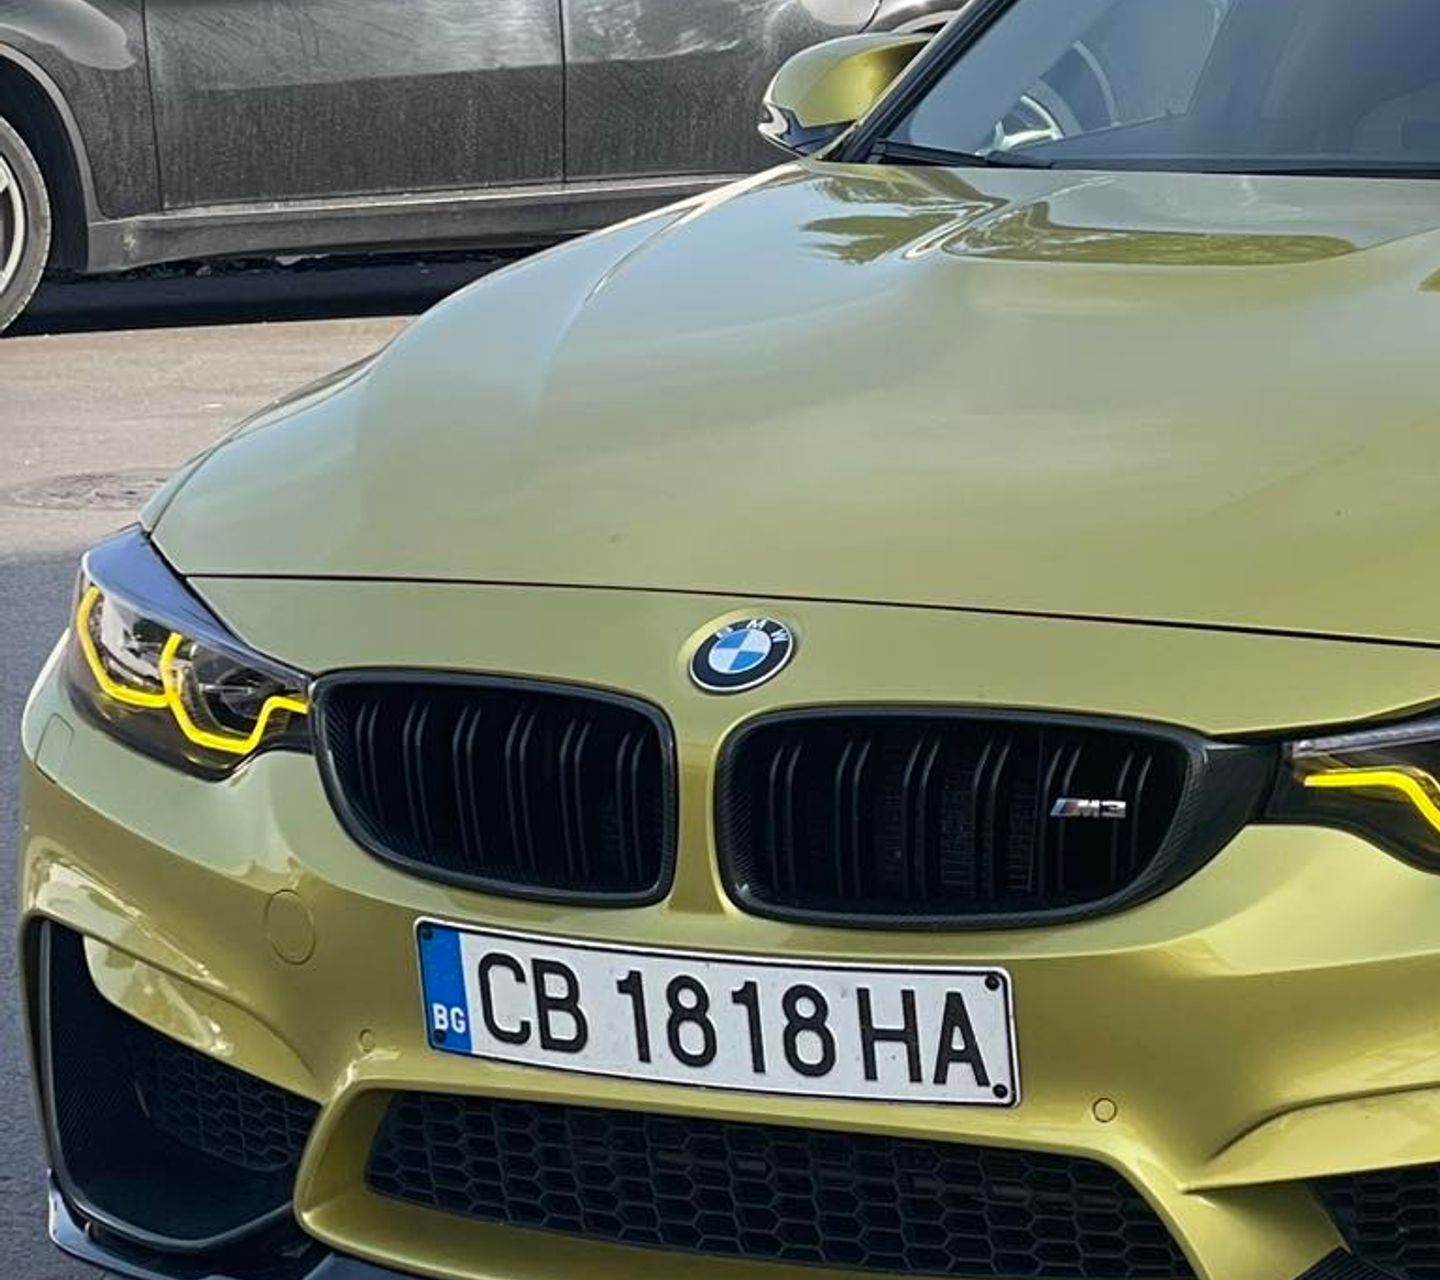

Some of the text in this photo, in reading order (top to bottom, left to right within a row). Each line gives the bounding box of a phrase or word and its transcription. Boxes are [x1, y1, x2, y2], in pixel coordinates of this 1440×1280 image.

[715, 619, 789, 643] BMW
[432, 1002, 466, 1034] BG
[477, 951, 990, 1087] CB 1818 HA
